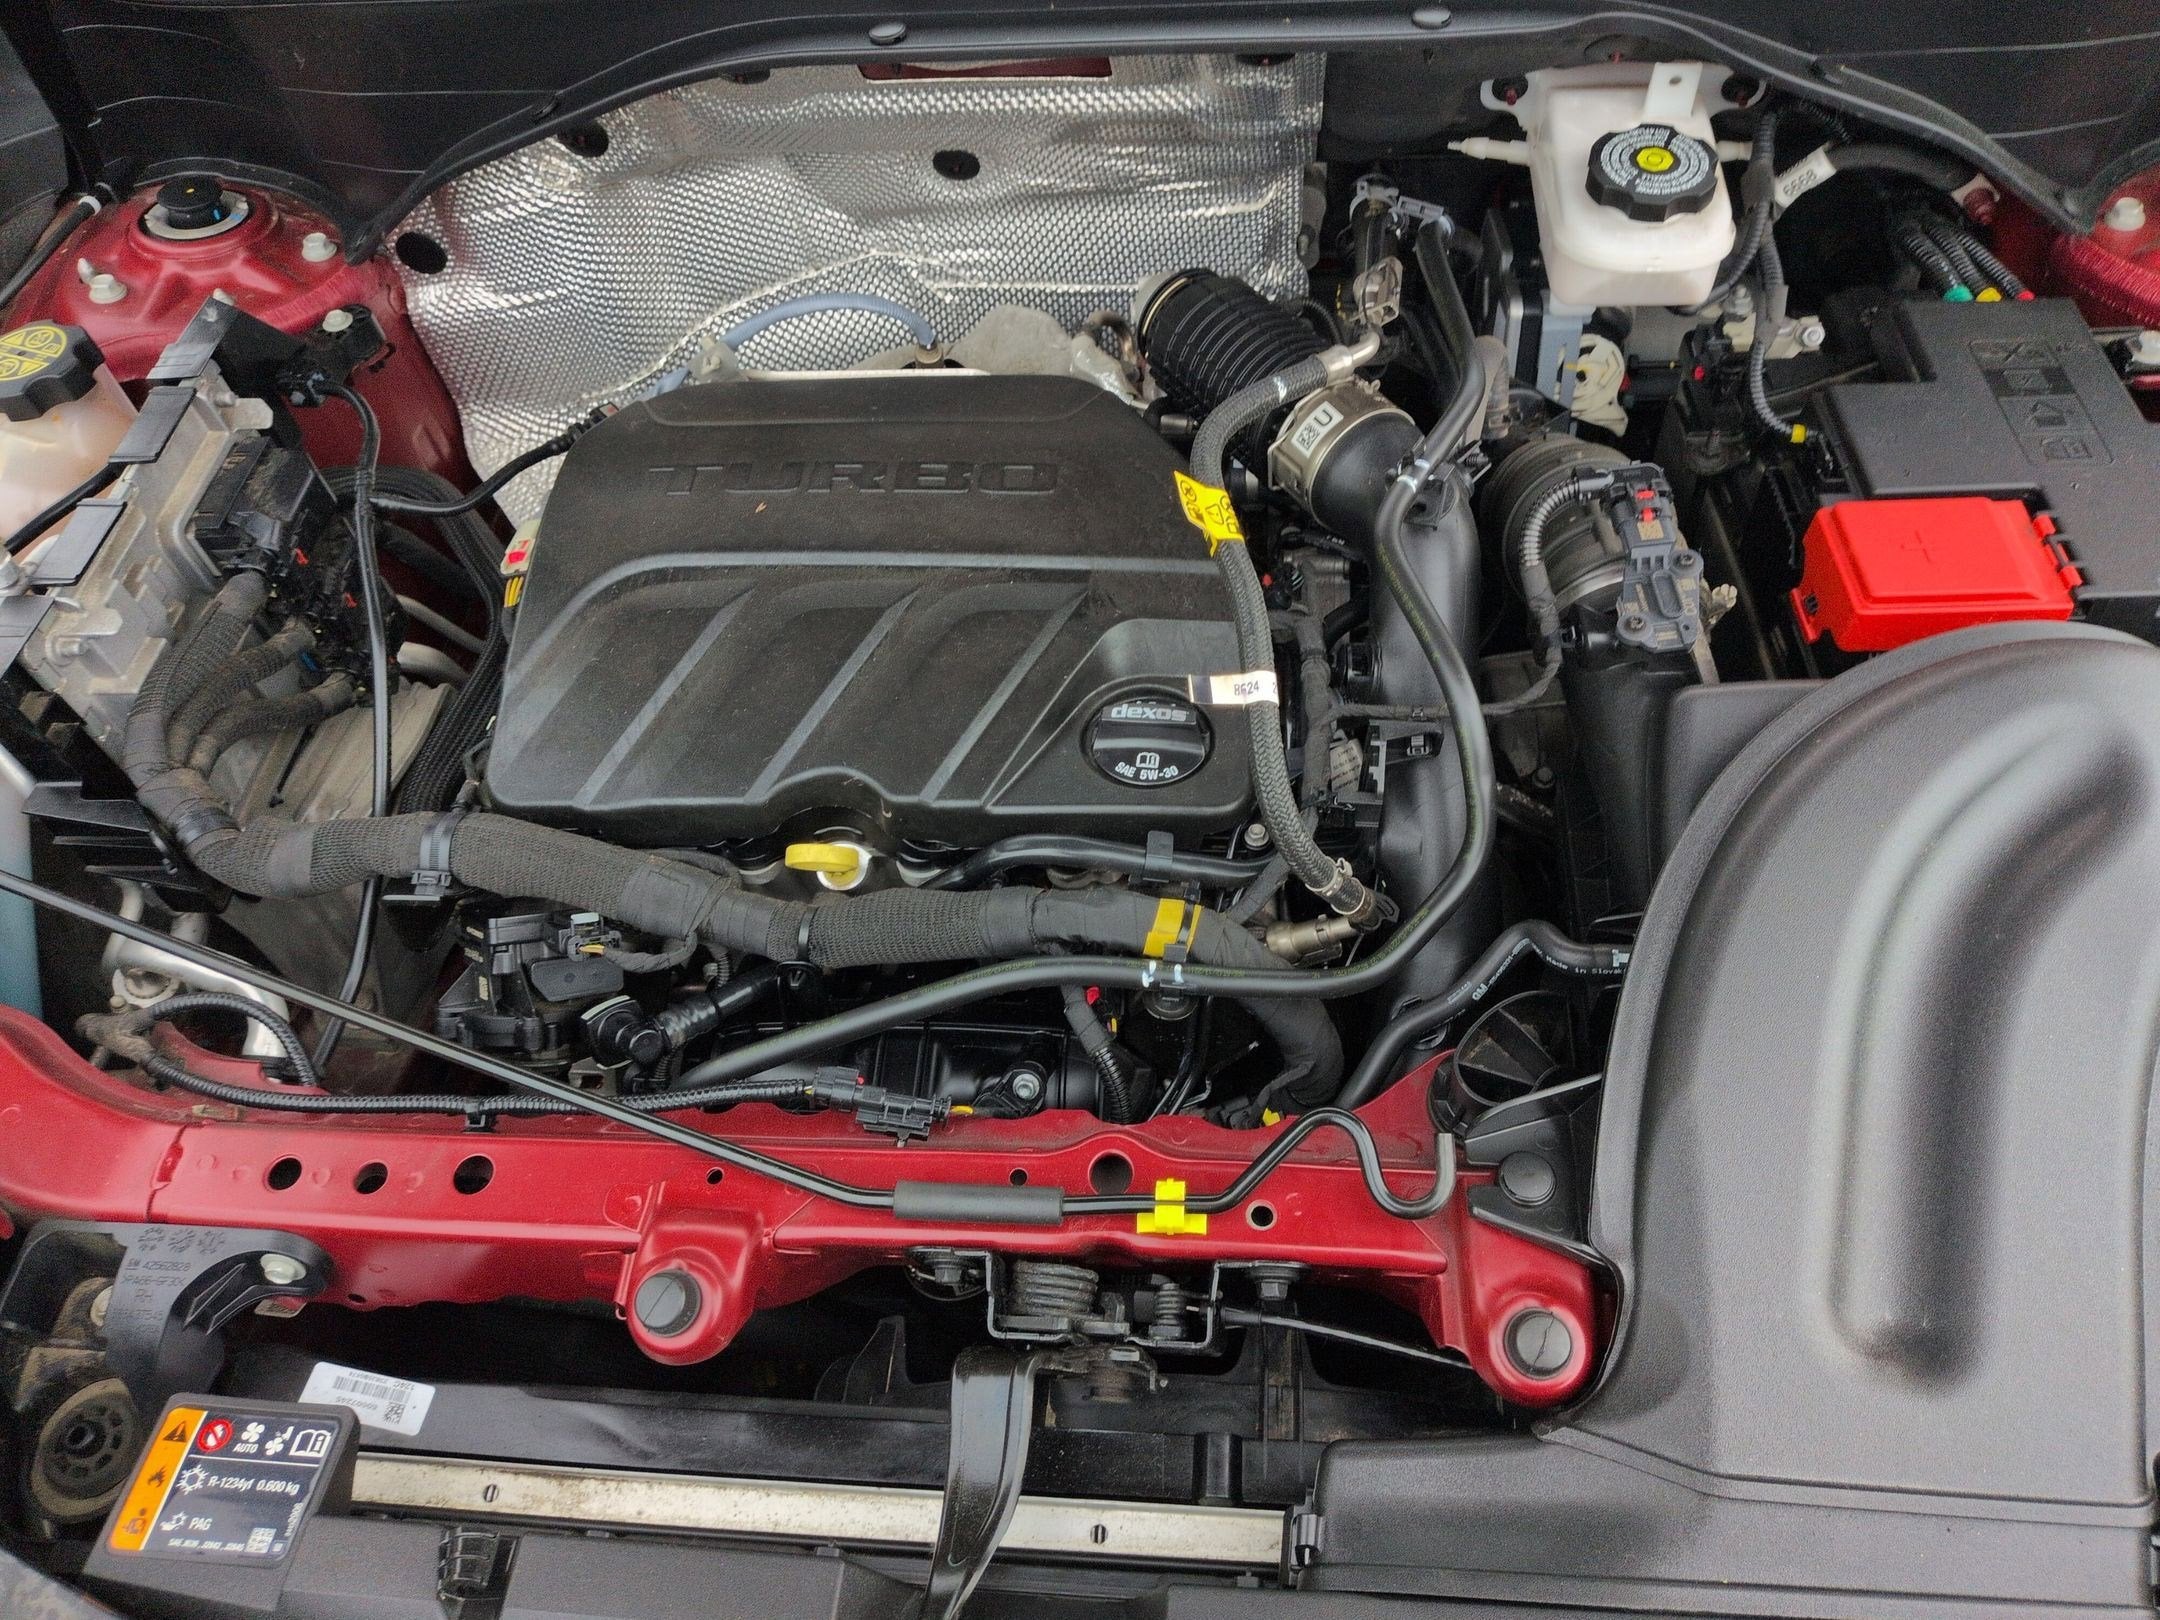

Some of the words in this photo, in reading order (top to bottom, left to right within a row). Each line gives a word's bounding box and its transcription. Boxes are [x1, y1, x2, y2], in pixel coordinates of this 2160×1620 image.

[1313, 409, 1333, 427] U
[648, 461, 1059, 497] TURBO
[1111, 703, 1187, 722] dexos
[1114, 761, 1137, 778] SAE
[1139, 765, 1180, 781] 5W-30
[233, 1443, 259, 1454] AUTO
[207, 1476, 255, 1492] R-1234yf
[256, 1480, 285, 1493] 0.600
[286, 1482, 300, 1495] kg
[188, 1517, 213, 1531] PAG
